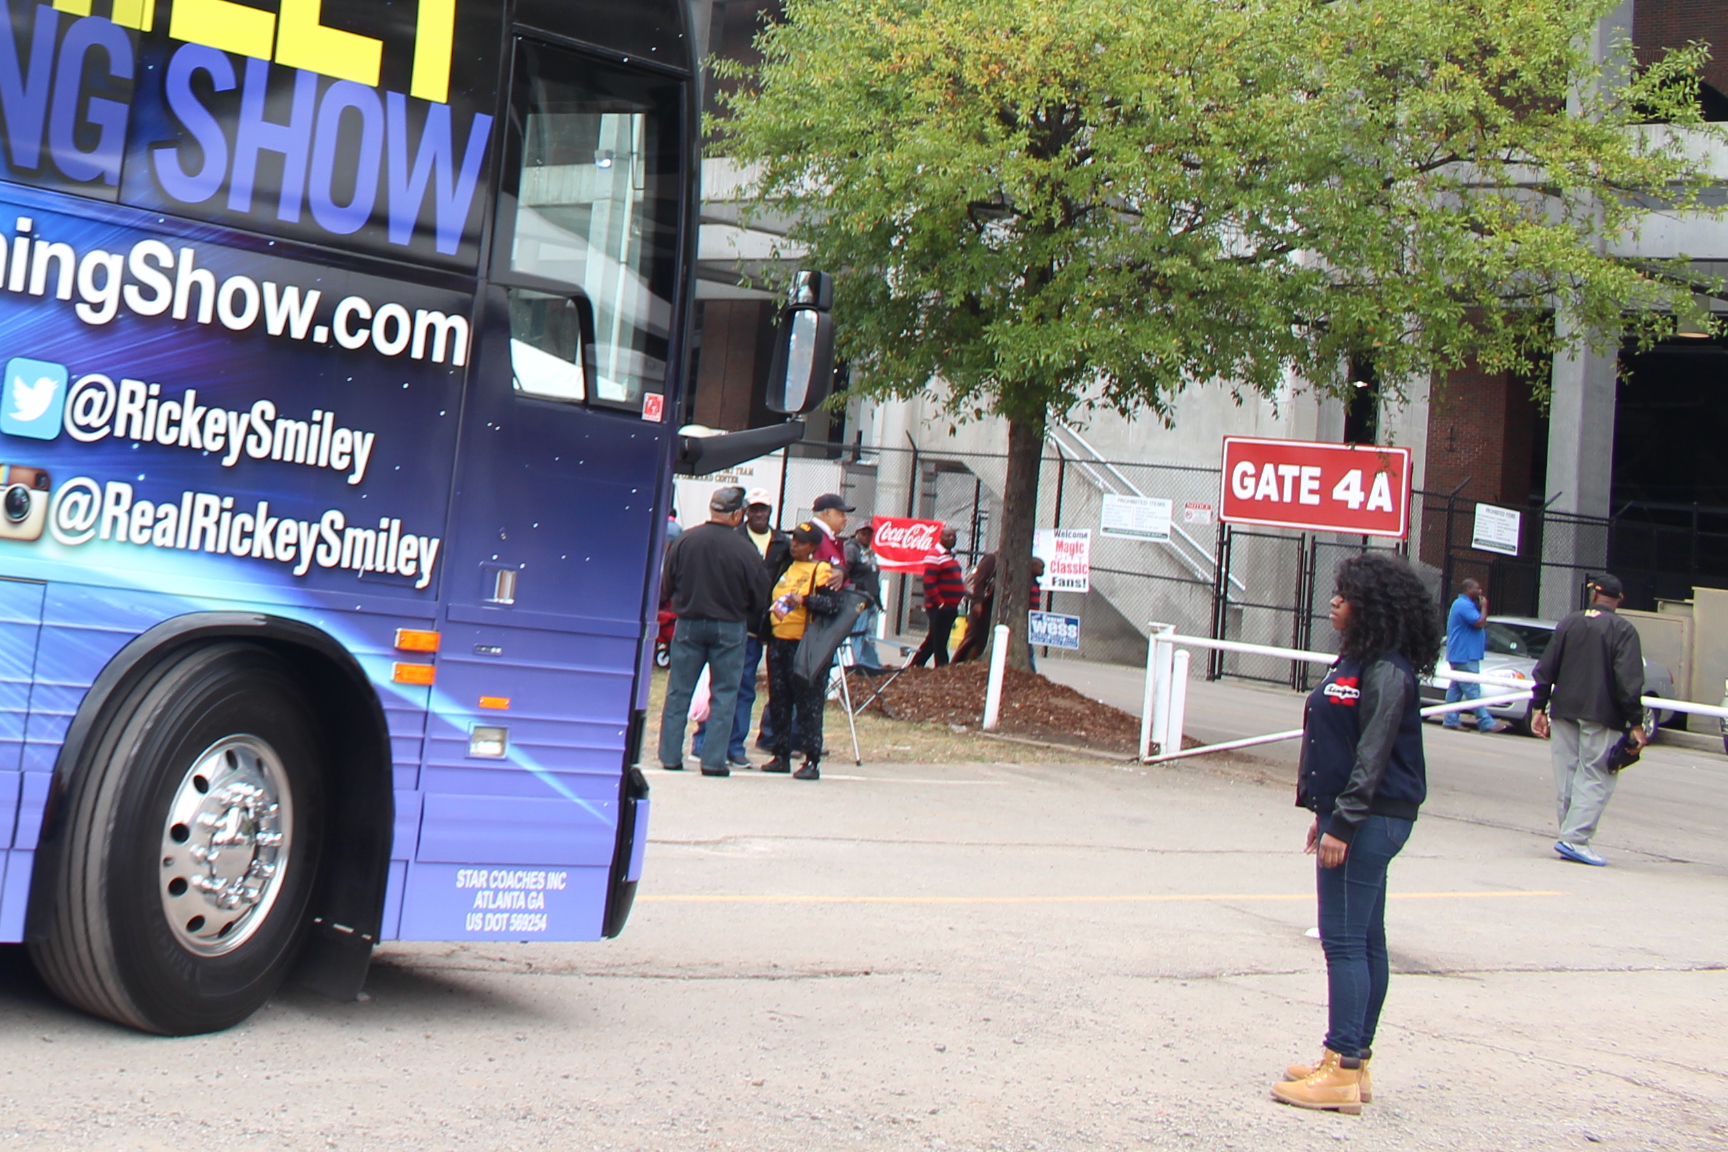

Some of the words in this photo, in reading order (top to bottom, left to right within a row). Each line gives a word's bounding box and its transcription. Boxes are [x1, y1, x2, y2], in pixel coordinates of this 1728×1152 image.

[153, 41, 493, 256] SHOW
[63, 373, 374, 485] @RickeySmiley
[1232, 460, 1322, 506] GATE
[1332, 469, 1393, 513] 4A
[48, 477, 440, 589] @RealRickeySmiley
[1053, 528, 1089, 539] Welcome
[1055, 539, 1085, 557] Magic
[1050, 559, 1089, 575] Classic
[1052, 576, 1087, 588] Fans!
[456, 869, 489, 888] STAR
[489, 869, 546, 889] COACHES
[546, 871, 568, 890] INC
[473, 890, 526, 909] ATLANTA
[527, 891, 545, 910] GA
[465, 912, 485, 931] US
[484, 912, 511, 932] DOT
